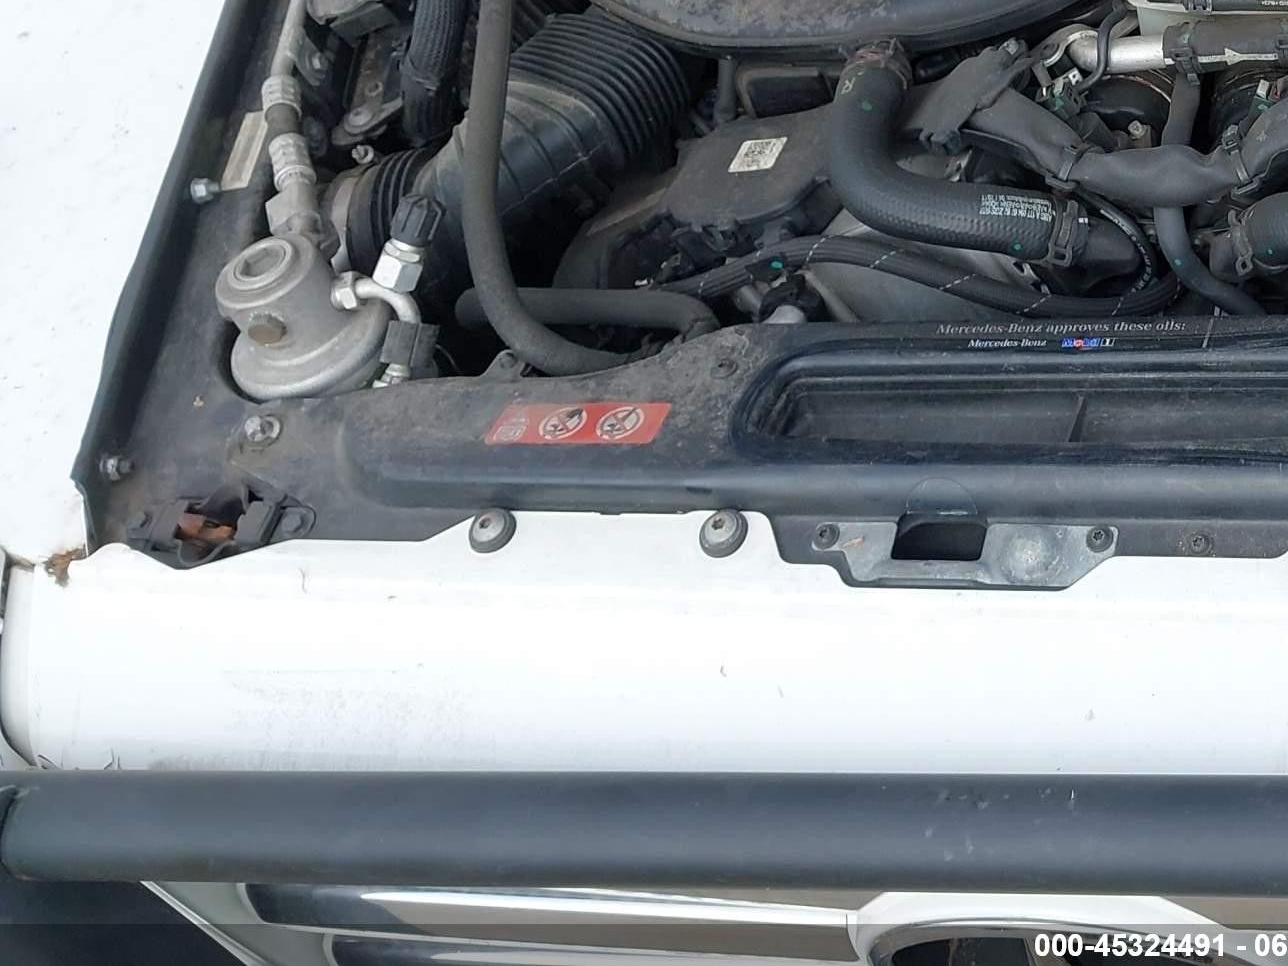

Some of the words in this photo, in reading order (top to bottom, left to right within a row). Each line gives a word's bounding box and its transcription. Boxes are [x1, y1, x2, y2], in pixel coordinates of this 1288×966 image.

[936, 323, 1042, 333] Mercedes-Benz
[1046, 324, 1109, 334] approves
[1114, 322, 1151, 331] these
[1155, 321, 1187, 331] oils:
[968, 339, 1047, 347] Mercedes-Benz
[1061, 337, 1100, 347] Mobil
